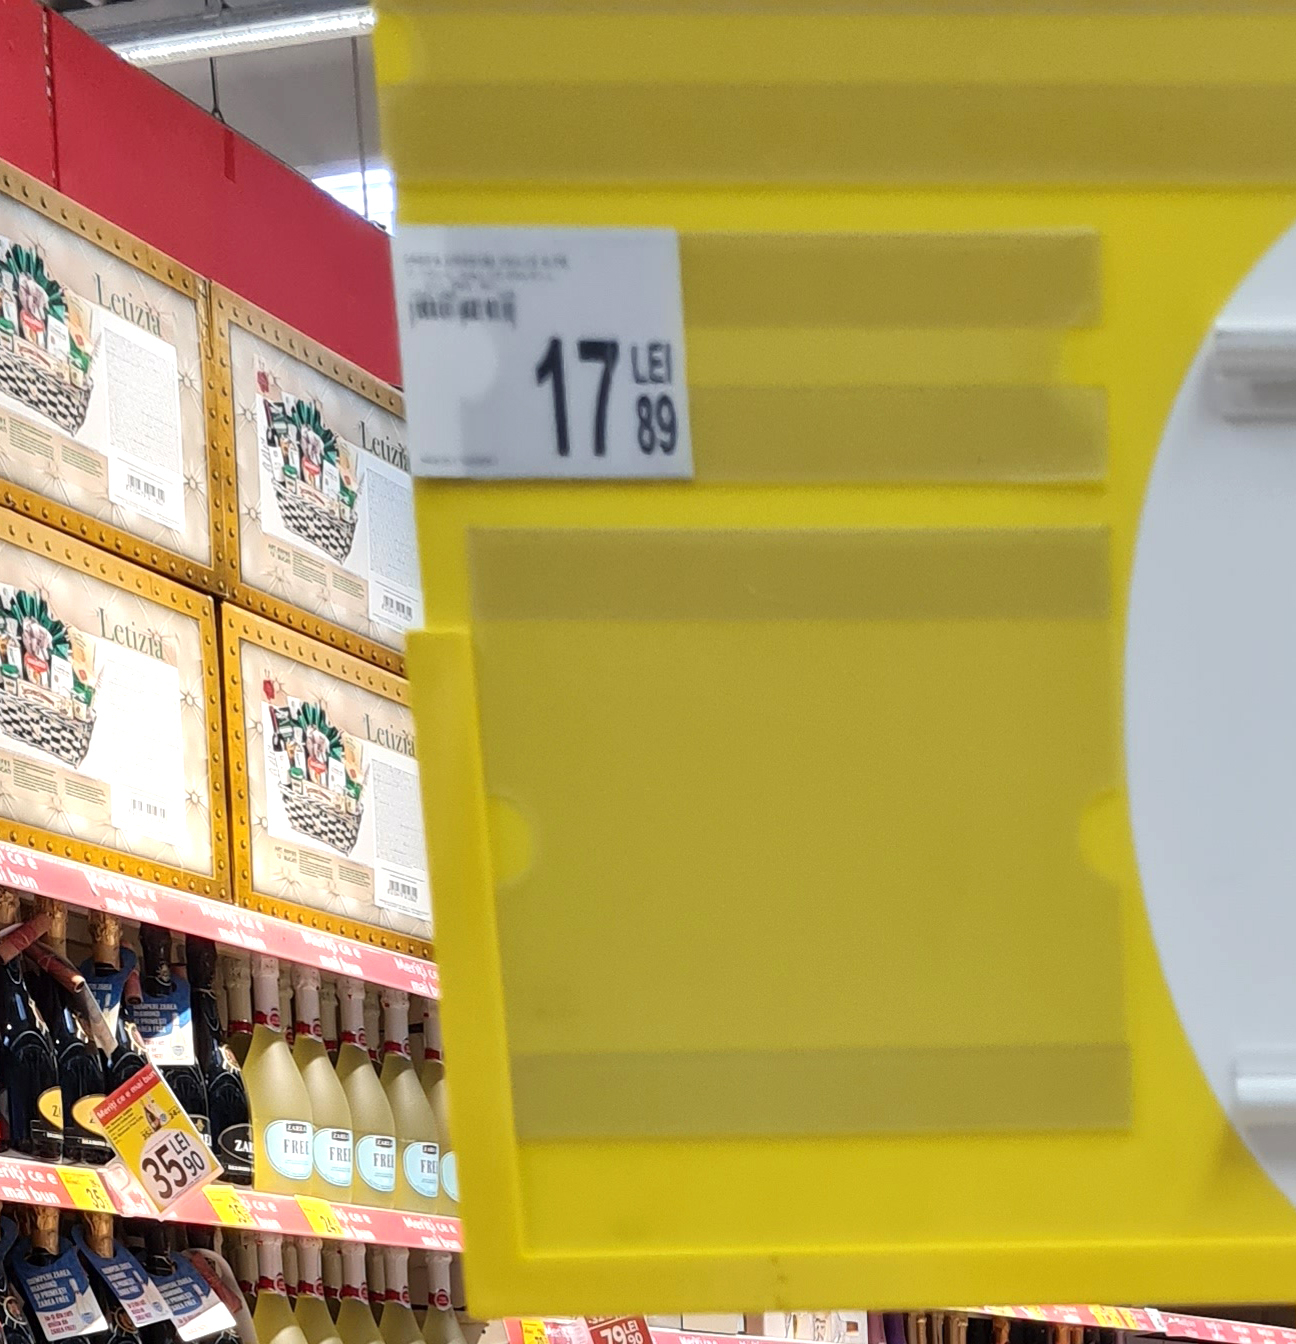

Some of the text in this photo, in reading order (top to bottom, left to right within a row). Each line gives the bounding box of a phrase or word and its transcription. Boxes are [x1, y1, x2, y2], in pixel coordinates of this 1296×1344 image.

[94, 272, 162, 337] Letizia
[631, 342, 672, 384] LEI
[535, 337, 619, 456] 17
[636, 395, 676, 454] 89
[97, 607, 163, 660] Letizia
[170, 1131, 191, 1155] LEI
[183, 1150, 205, 1176] 90
[25, 1170, 57, 1185] ce e
[141, 1144, 188, 1199] 35
[3, 1186, 60, 1204] mai bun
[624, 1320, 639, 1334] LEI
